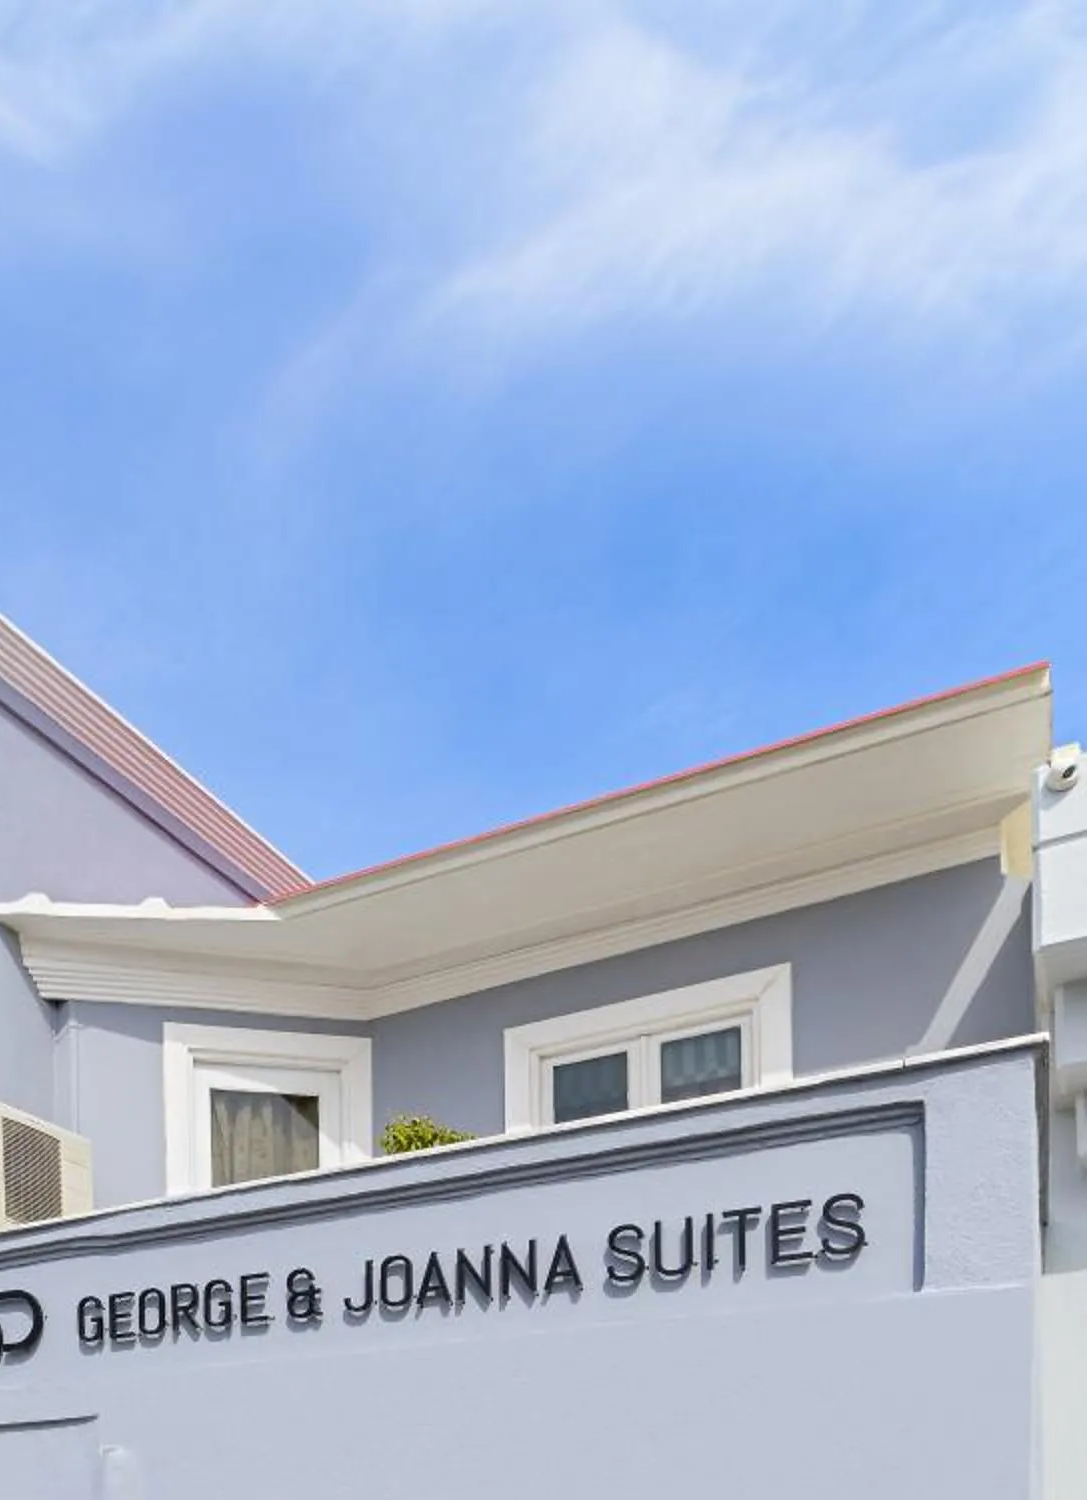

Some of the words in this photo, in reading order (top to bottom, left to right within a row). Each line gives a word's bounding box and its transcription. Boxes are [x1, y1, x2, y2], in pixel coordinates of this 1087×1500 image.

[77, 1272, 273, 1342] GEORGE
[286, 1267, 323, 1319] &
[343, 1233, 583, 1314] JOANNA
[606, 1193, 867, 1284] SUITES
